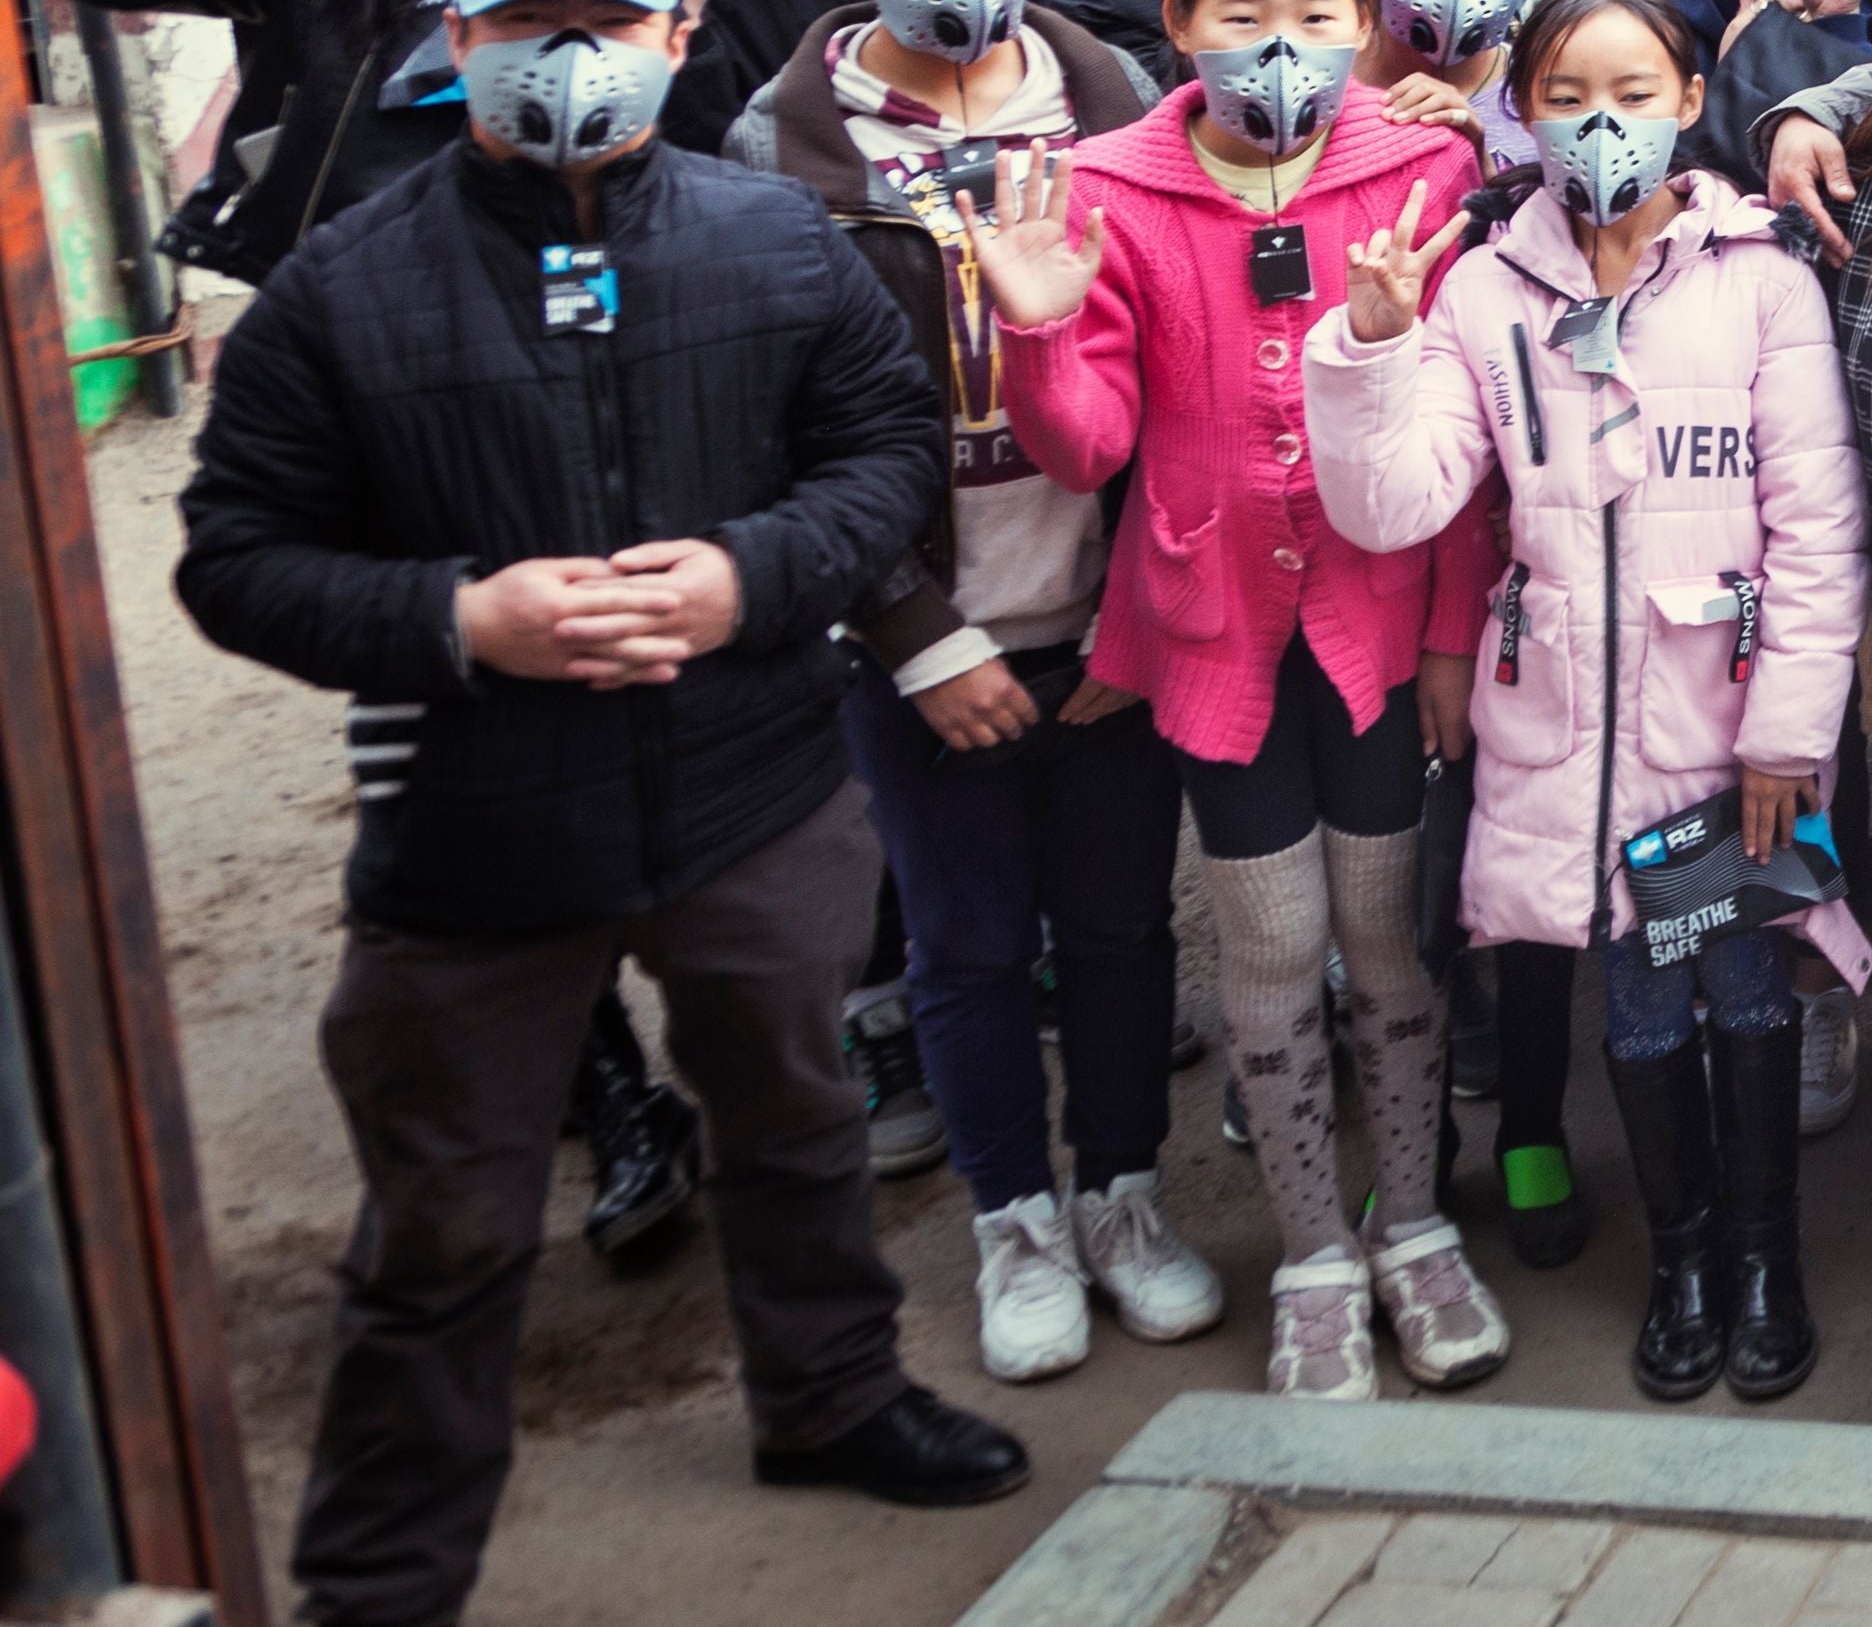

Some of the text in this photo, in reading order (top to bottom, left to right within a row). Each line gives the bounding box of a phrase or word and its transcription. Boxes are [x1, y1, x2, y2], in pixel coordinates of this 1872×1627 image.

[1656, 425, 1755, 478] VERS
[1503, 581, 1520, 656] SNOW
[1735, 579, 1756, 655] SNOW
[1666, 819, 1706, 849] RZ
[1647, 897, 1738, 945] BREATHE
[1651, 934, 1702, 967] SAFE
